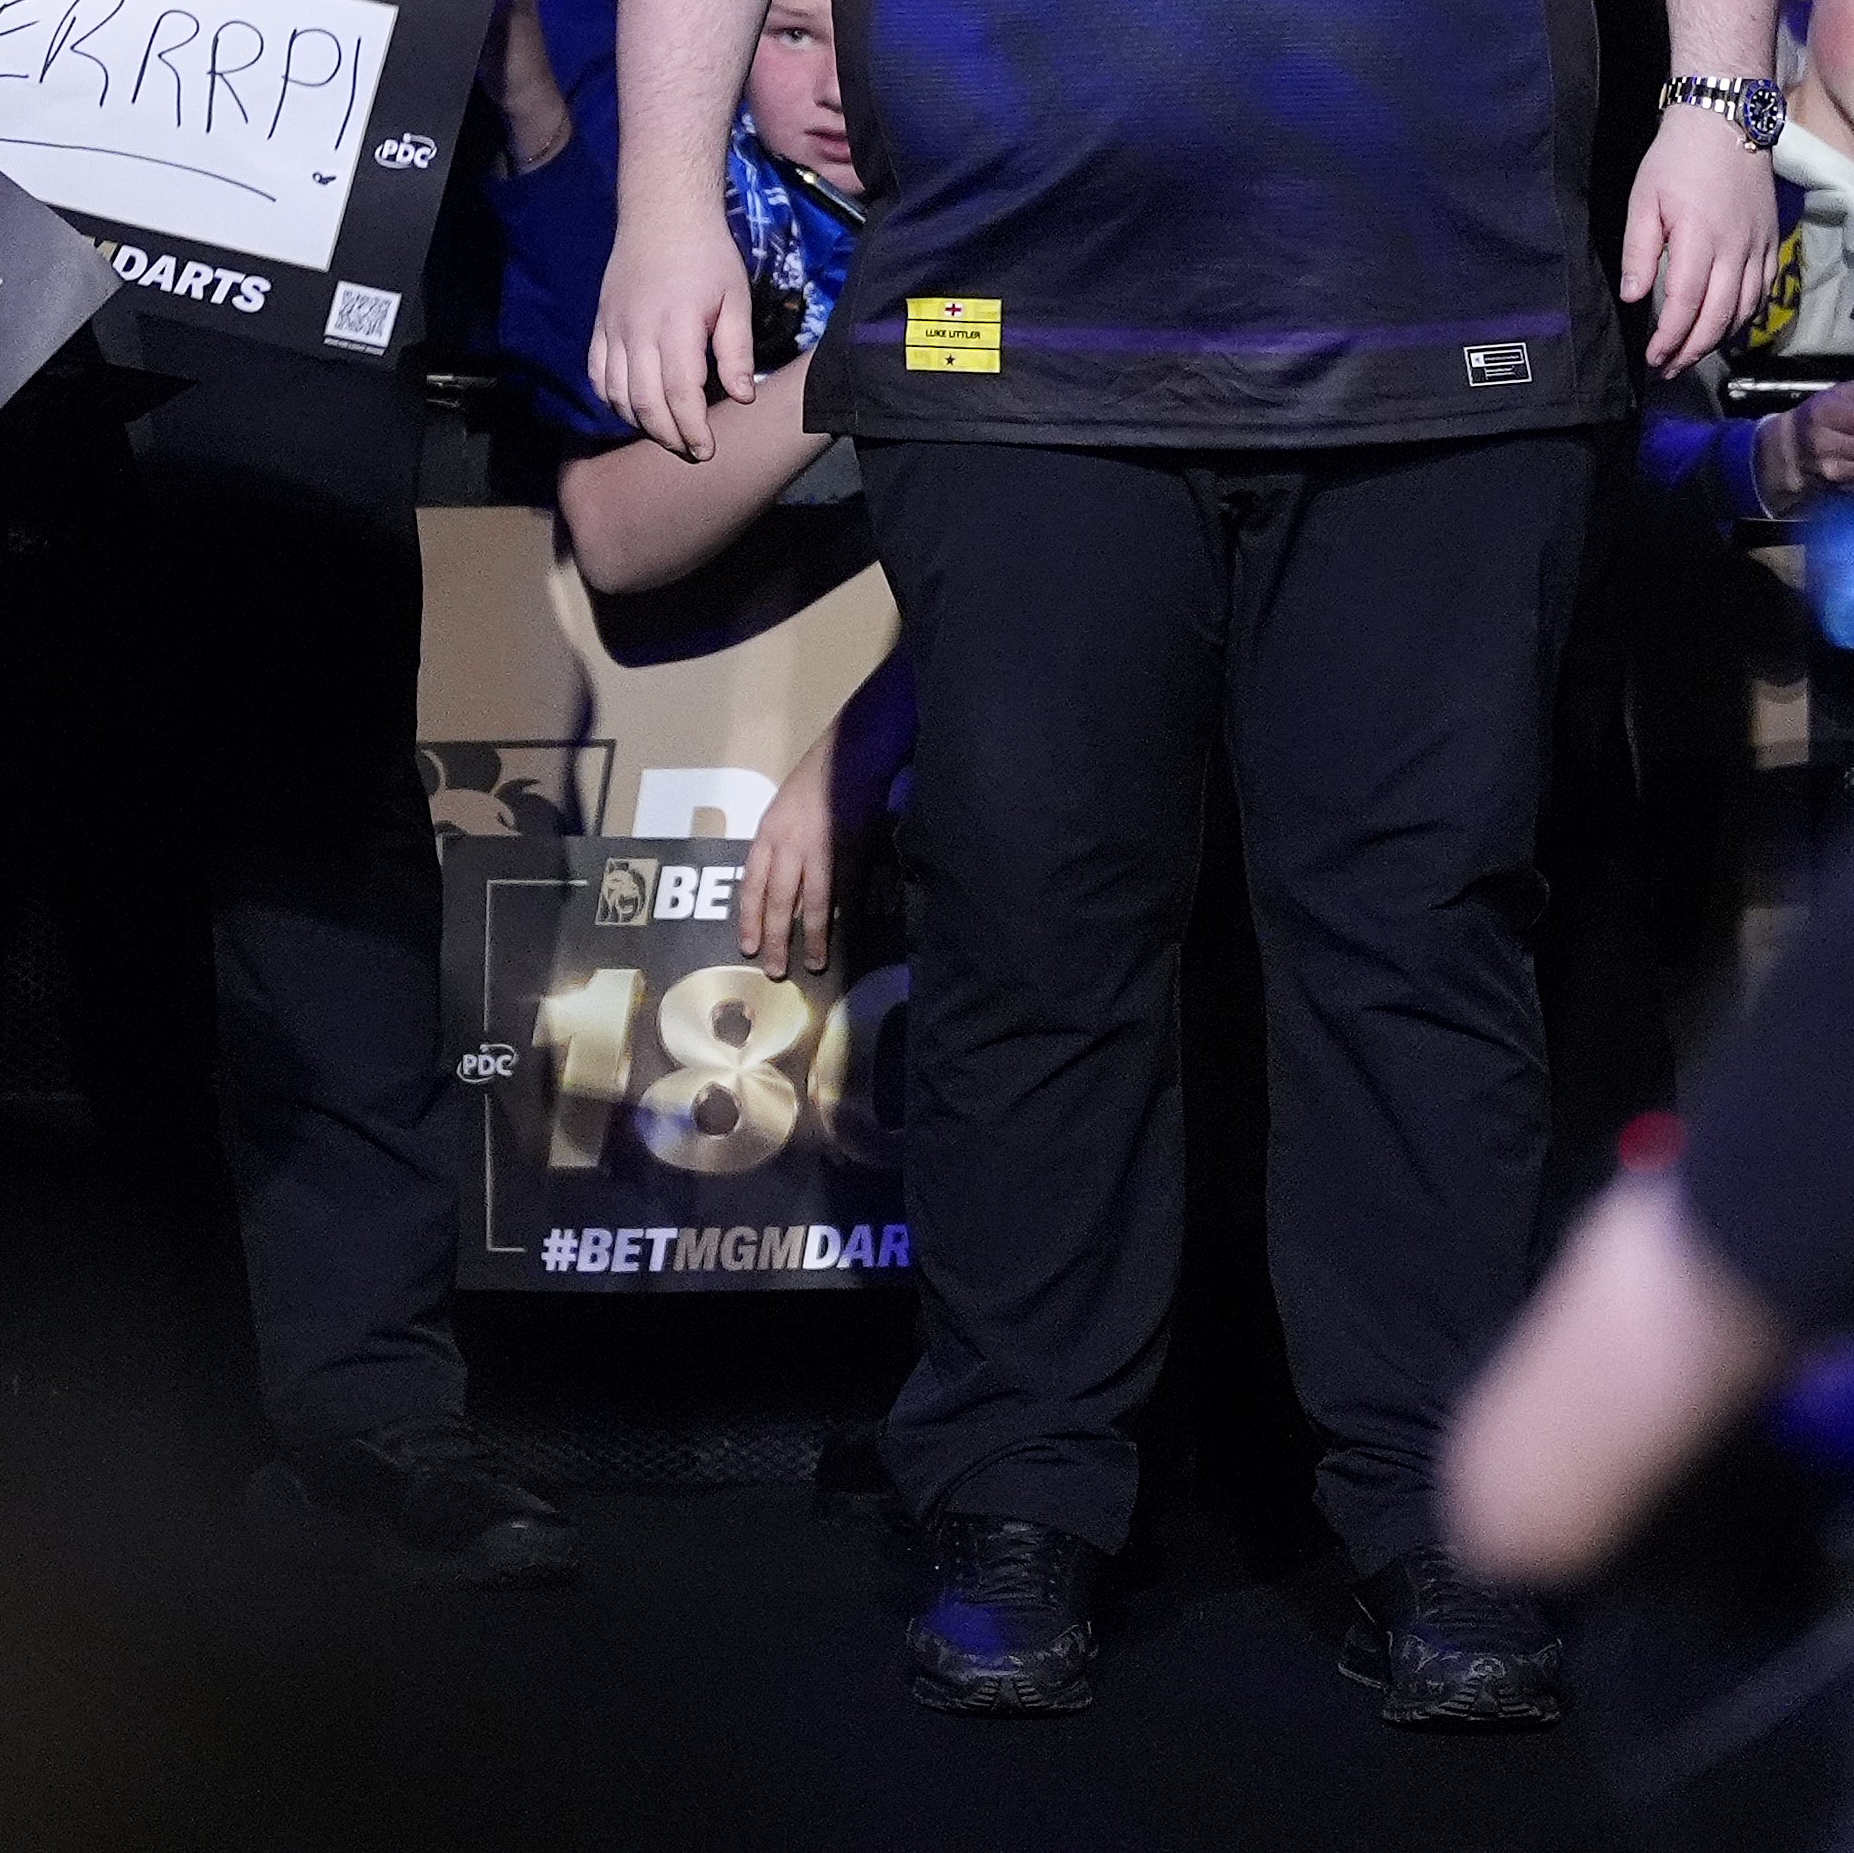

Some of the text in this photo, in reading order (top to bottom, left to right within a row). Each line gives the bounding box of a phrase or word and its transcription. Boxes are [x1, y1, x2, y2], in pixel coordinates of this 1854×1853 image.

[374, 131, 438, 170] PDC
[652, 863, 745, 923] BE
[457, 1043, 519, 1084] PDC
[540, 1223, 910, 1275] #BETMGMDAR
